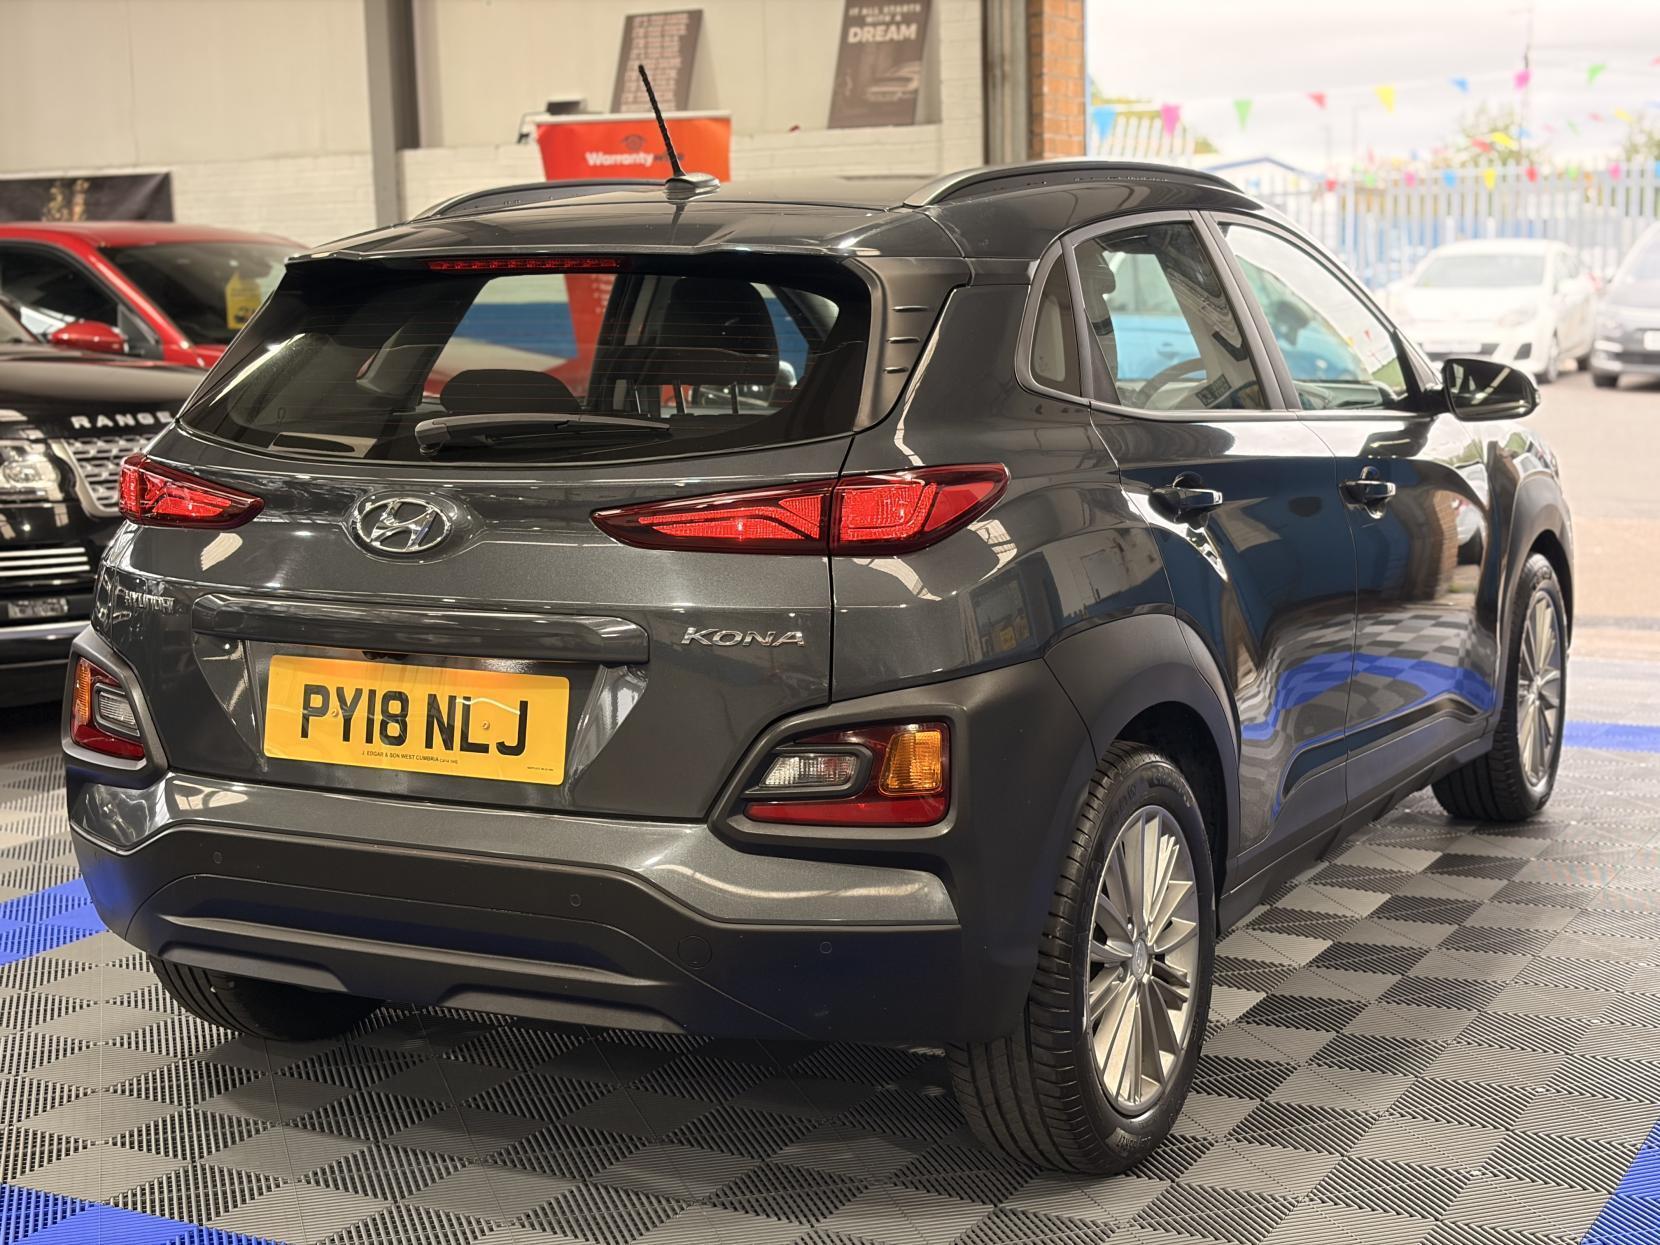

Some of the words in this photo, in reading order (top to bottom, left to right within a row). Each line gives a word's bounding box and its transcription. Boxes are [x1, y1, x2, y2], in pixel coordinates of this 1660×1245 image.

[883, 3, 921, 14] STARTS
[848, 23, 918, 44] DREAM
[585, 151, 684, 167] Warranty
[71, 411, 172, 429] RANGE
[681, 627, 805, 646] KONA
[301, 683, 409, 746] PY18
[425, 693, 529, 757] NLJ
[415, 754, 439, 762] CUMBRIA
